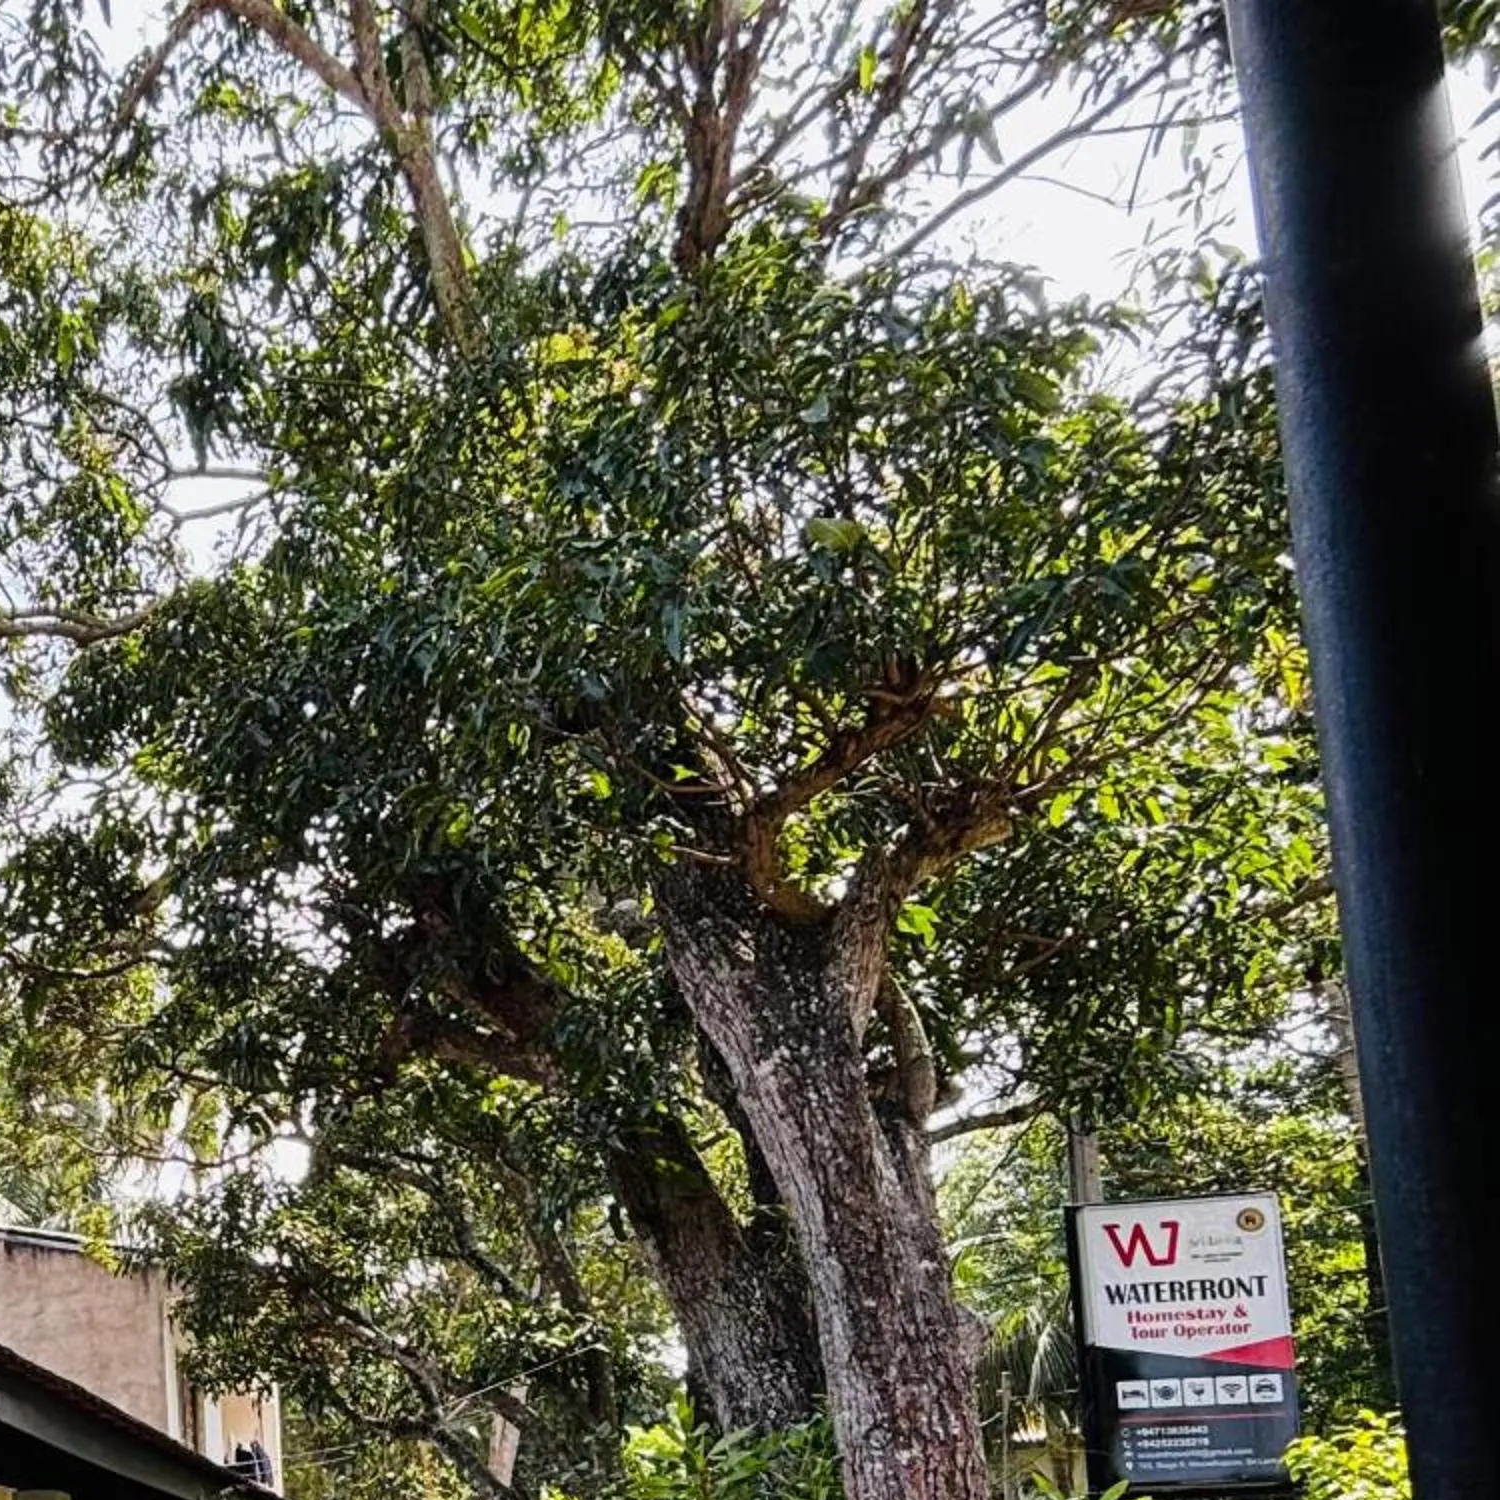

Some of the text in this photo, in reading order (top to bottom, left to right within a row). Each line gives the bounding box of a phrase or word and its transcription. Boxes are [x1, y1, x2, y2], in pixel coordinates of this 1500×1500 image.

[1105, 1275, 1268, 1305] WATERFRONT
[1127, 1303, 1249, 1324] Homestay &
[1130, 1322, 1252, 1340] Tour Operator
